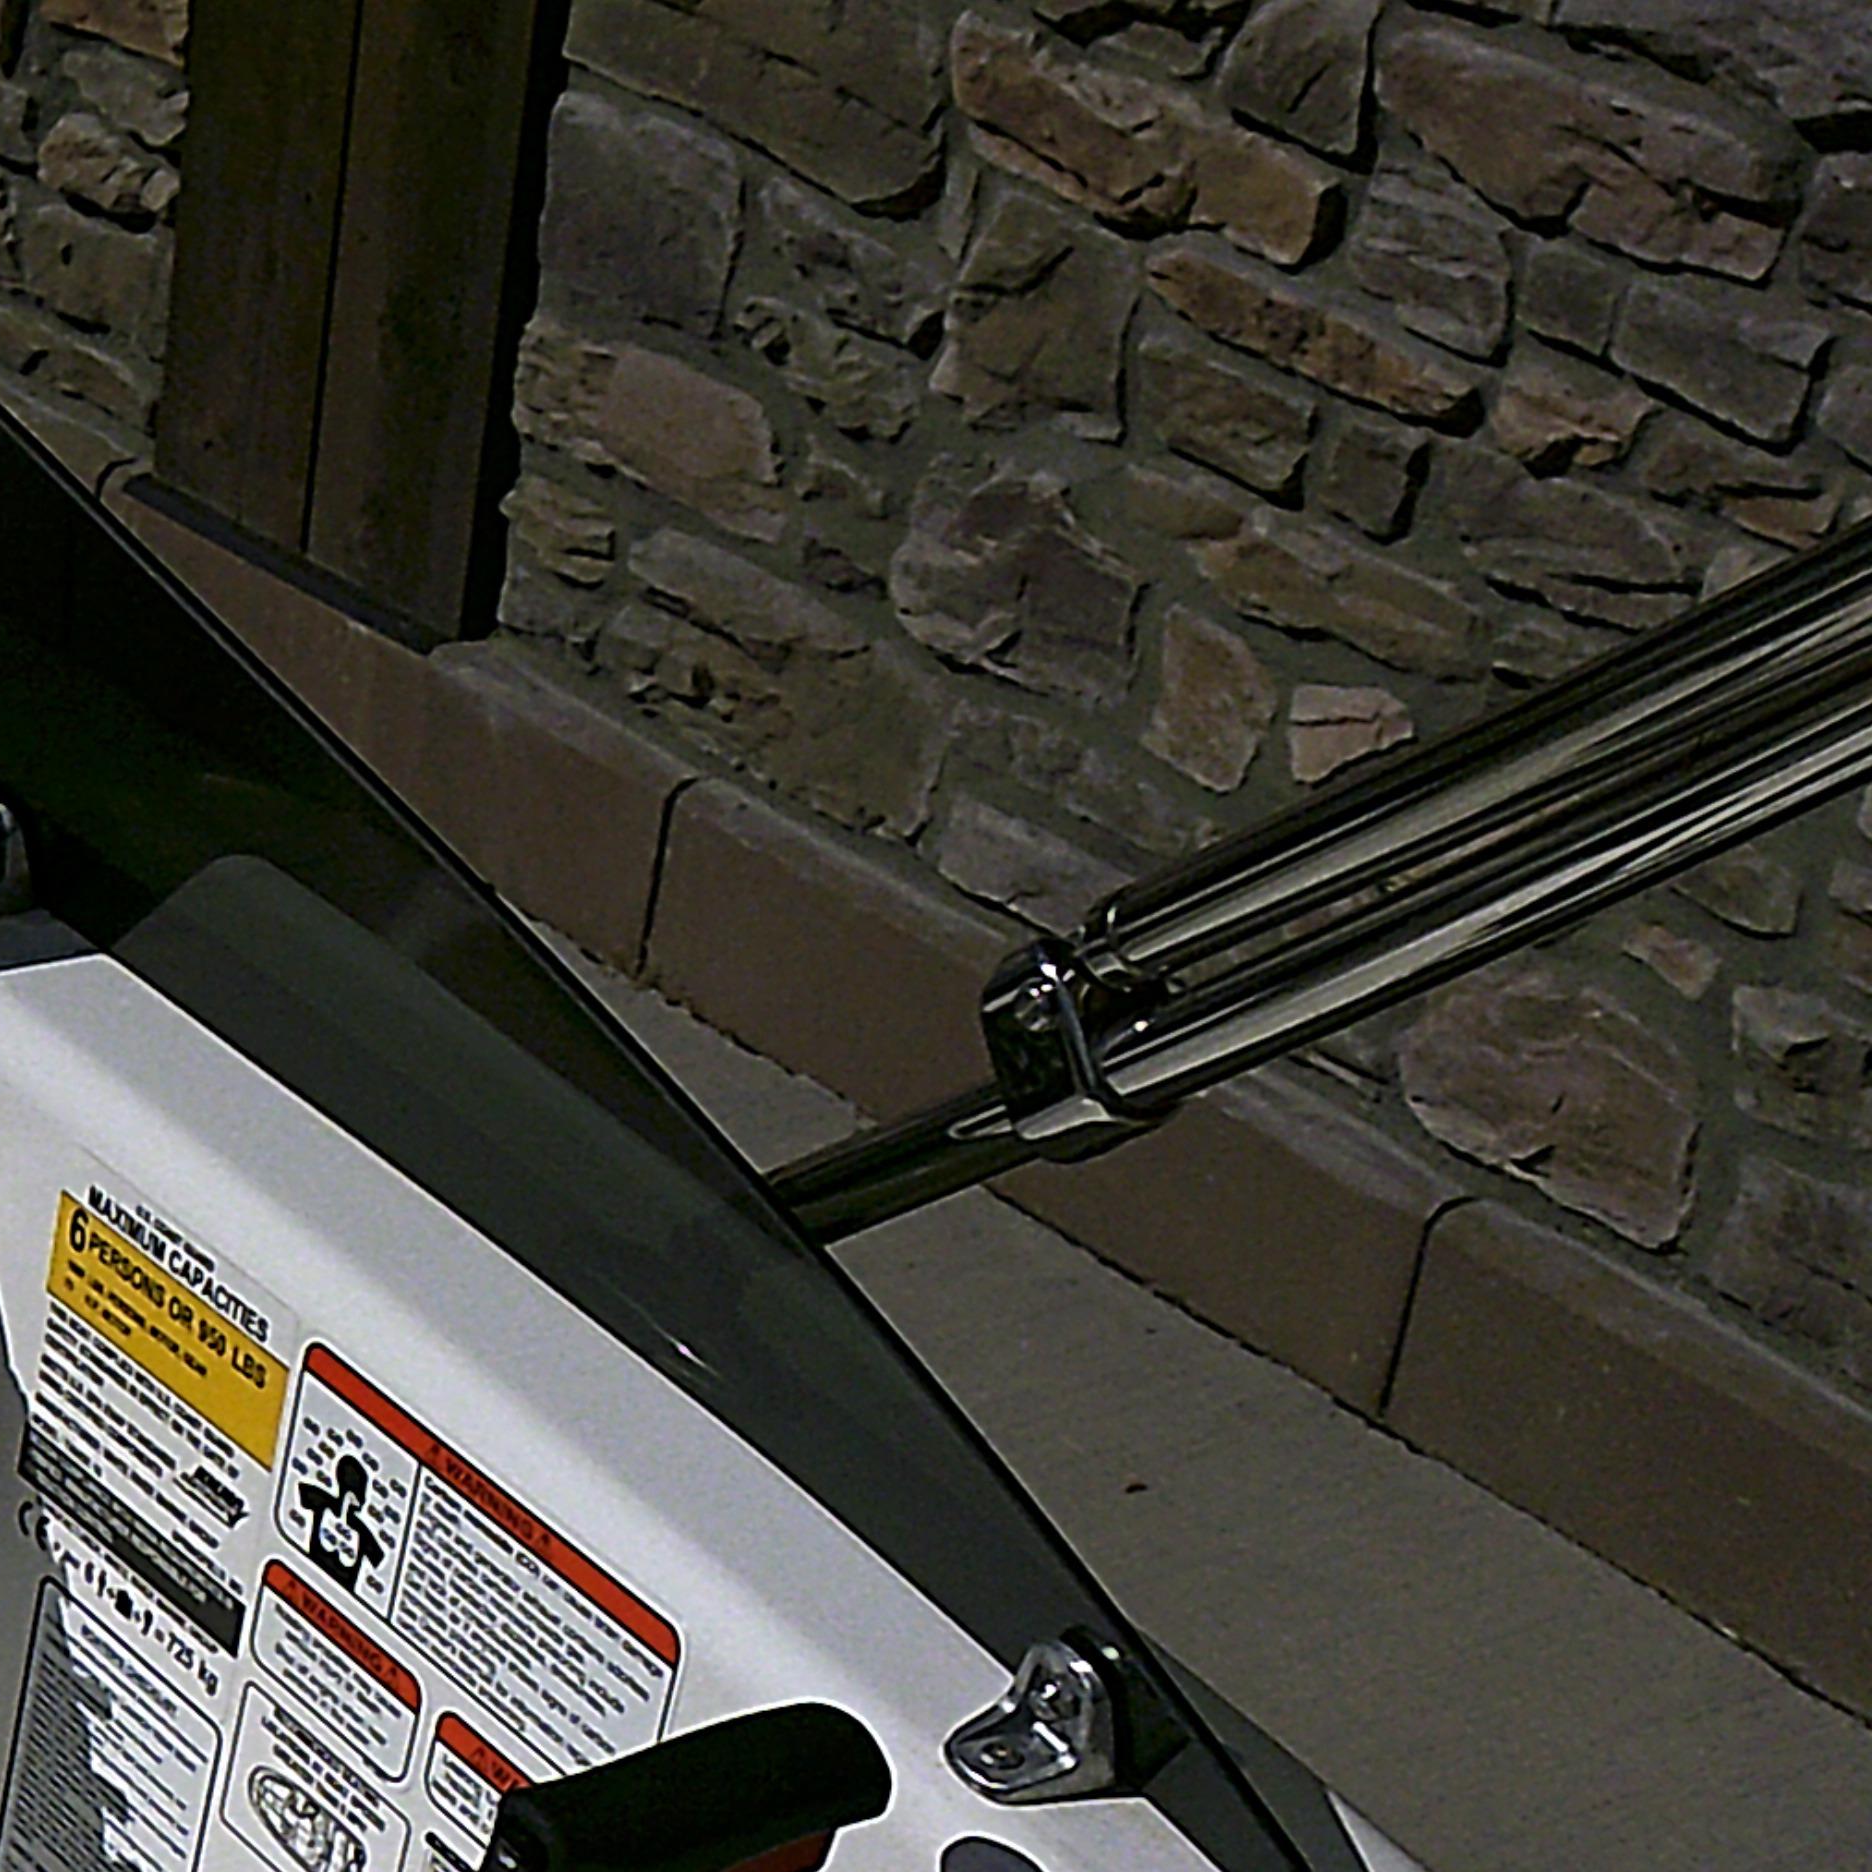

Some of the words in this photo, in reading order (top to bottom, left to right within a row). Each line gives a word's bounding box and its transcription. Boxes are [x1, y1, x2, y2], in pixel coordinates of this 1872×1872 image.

[69, 1208, 89, 1253] 6
[88, 1232, 166, 1310] PERSONS
[168, 1295, 194, 1333] OR
[230, 1343, 268, 1390] LBS
[88, 1184, 167, 1264] MAXIMUM
[167, 1248, 270, 1344] CAPACITIES
[444, 1458, 536, 1540] WARNING
